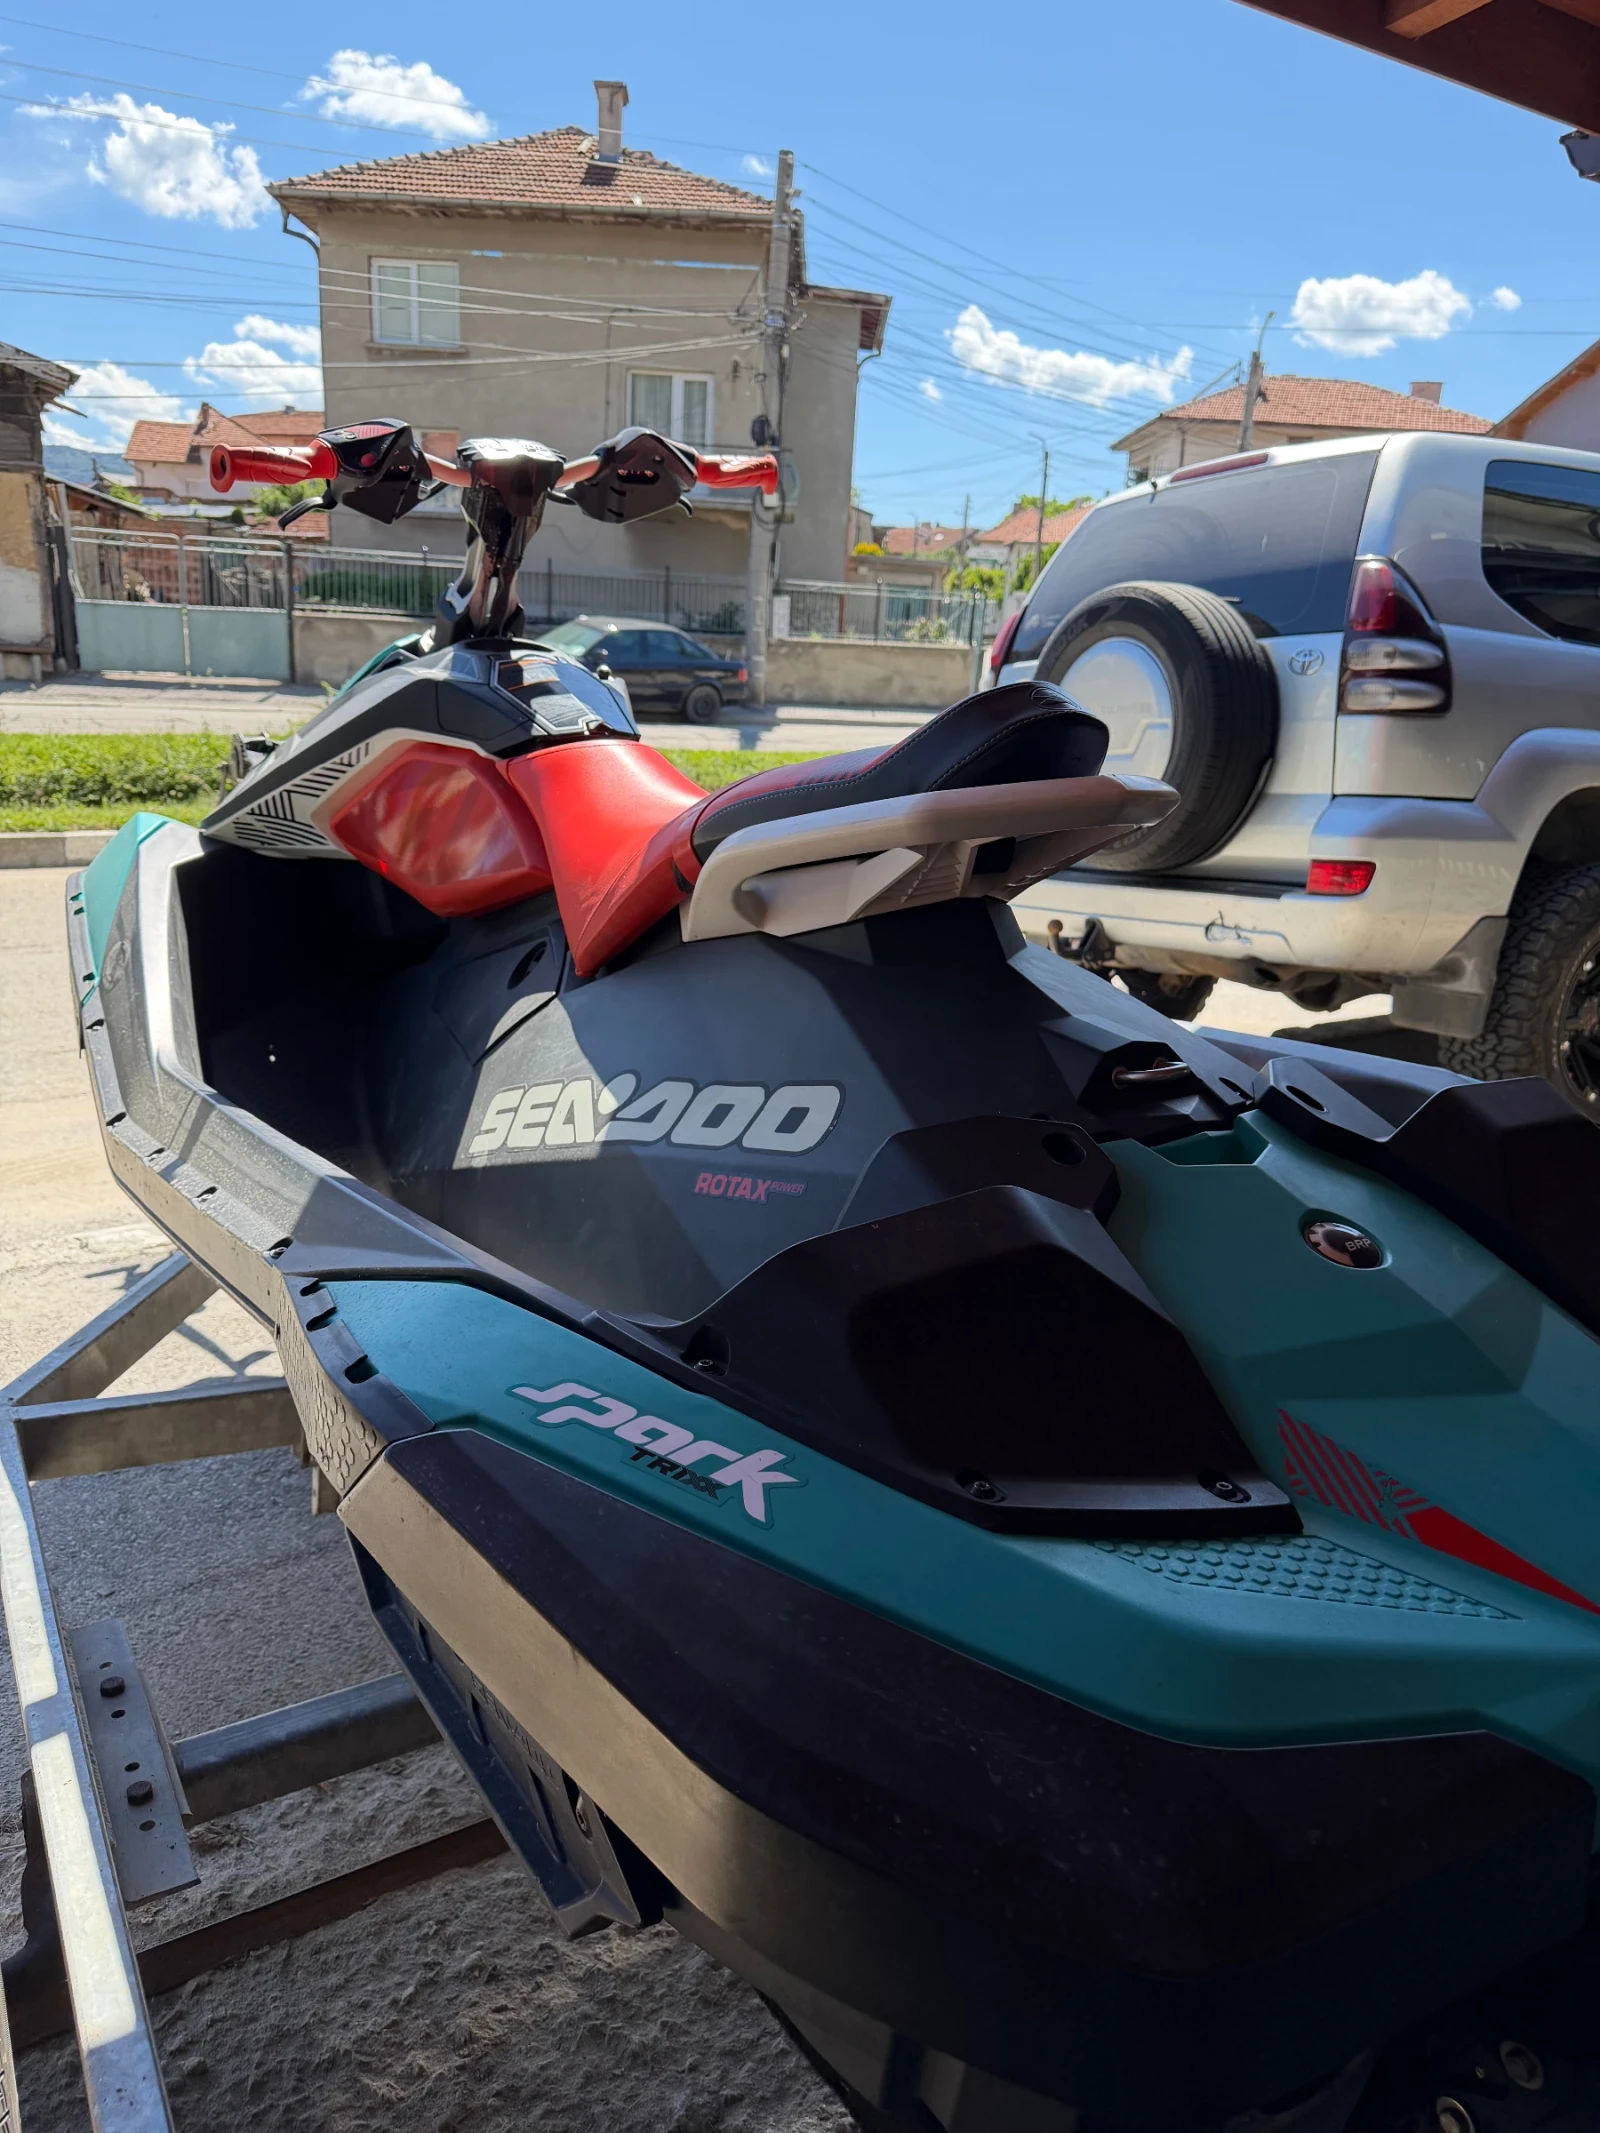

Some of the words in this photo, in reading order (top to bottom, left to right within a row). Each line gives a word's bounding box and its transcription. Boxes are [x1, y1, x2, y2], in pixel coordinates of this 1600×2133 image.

[694, 1172, 771, 1201] ROTAX
[770, 1181, 805, 1194] POWER
[1345, 1238, 1371, 1251] BRP
[629, 1445, 727, 1500] TRIXX
